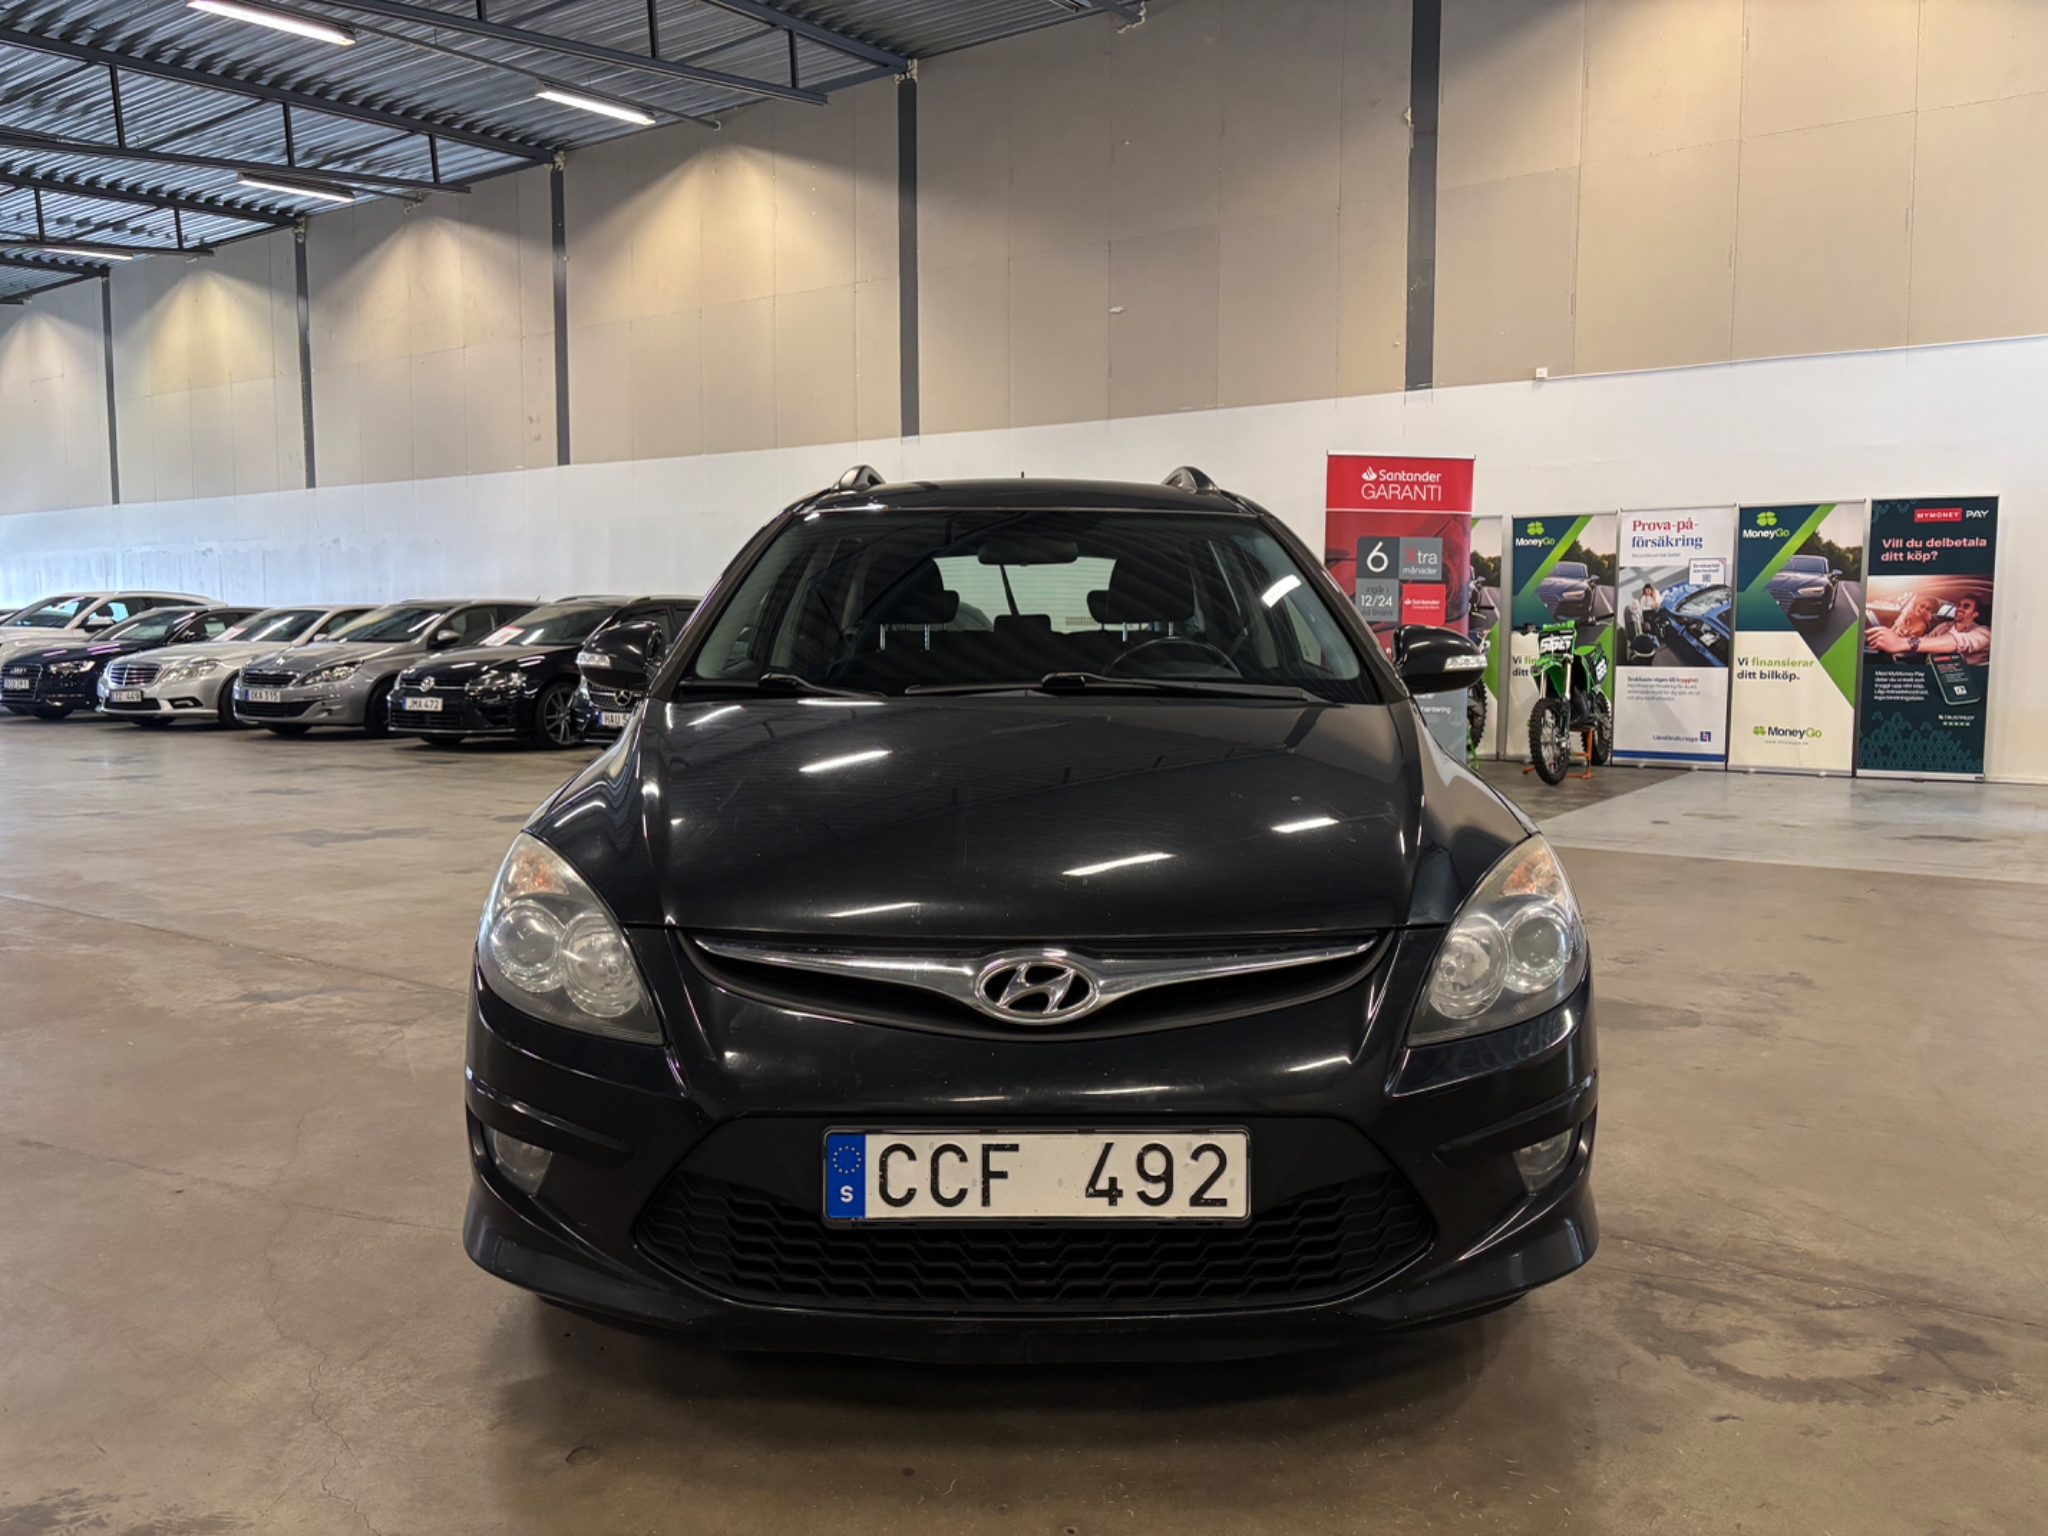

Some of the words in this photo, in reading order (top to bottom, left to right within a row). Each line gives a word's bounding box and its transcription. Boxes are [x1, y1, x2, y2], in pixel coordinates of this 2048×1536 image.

[1379, 469, 1441, 482] Santander
[1361, 483, 1442, 501] GARANTI
[1917, 511, 1959, 519] MYMONEY
[1965, 510, 1989, 519] PAY
[1632, 517, 1698, 533] Prova-på-
[1742, 528, 1790, 540] MoneyGo
[1515, 536, 1555, 548] MoneyGo
[1632, 535, 1703, 549] försäkring
[1882, 538, 1903, 548] Vill
[1906, 538, 1923, 548] du
[1925, 537, 1987, 548] delbetala
[1366, 541, 1389, 573] 6
[1404, 547, 1438, 564] Xtra
[1881, 551, 1904, 561] ditt
[1907, 550, 1938, 563] köp?
[1402, 566, 1437, 575] månader
[1366, 585, 1385, 594] ingår
[1360, 594, 1393, 607] 12/24
[1513, 656, 1522, 665] Vi
[1737, 657, 1748, 666] Vi
[1752, 657, 1814, 667] finansierar
[1513, 669, 1529, 677] ditt
[1737, 670, 1757, 679] ditt
[1759, 670, 1800, 682] bilköp.
[424, 700, 440, 710] 472
[1420, 706, 1452, 714] hantering
[604, 713, 620, 724] HAU
[1767, 726, 1822, 739] MoneyGo
[879, 1143, 1019, 1208] CCF
[1085, 1142, 1228, 1207] 492
[840, 1185, 854, 1203] S
